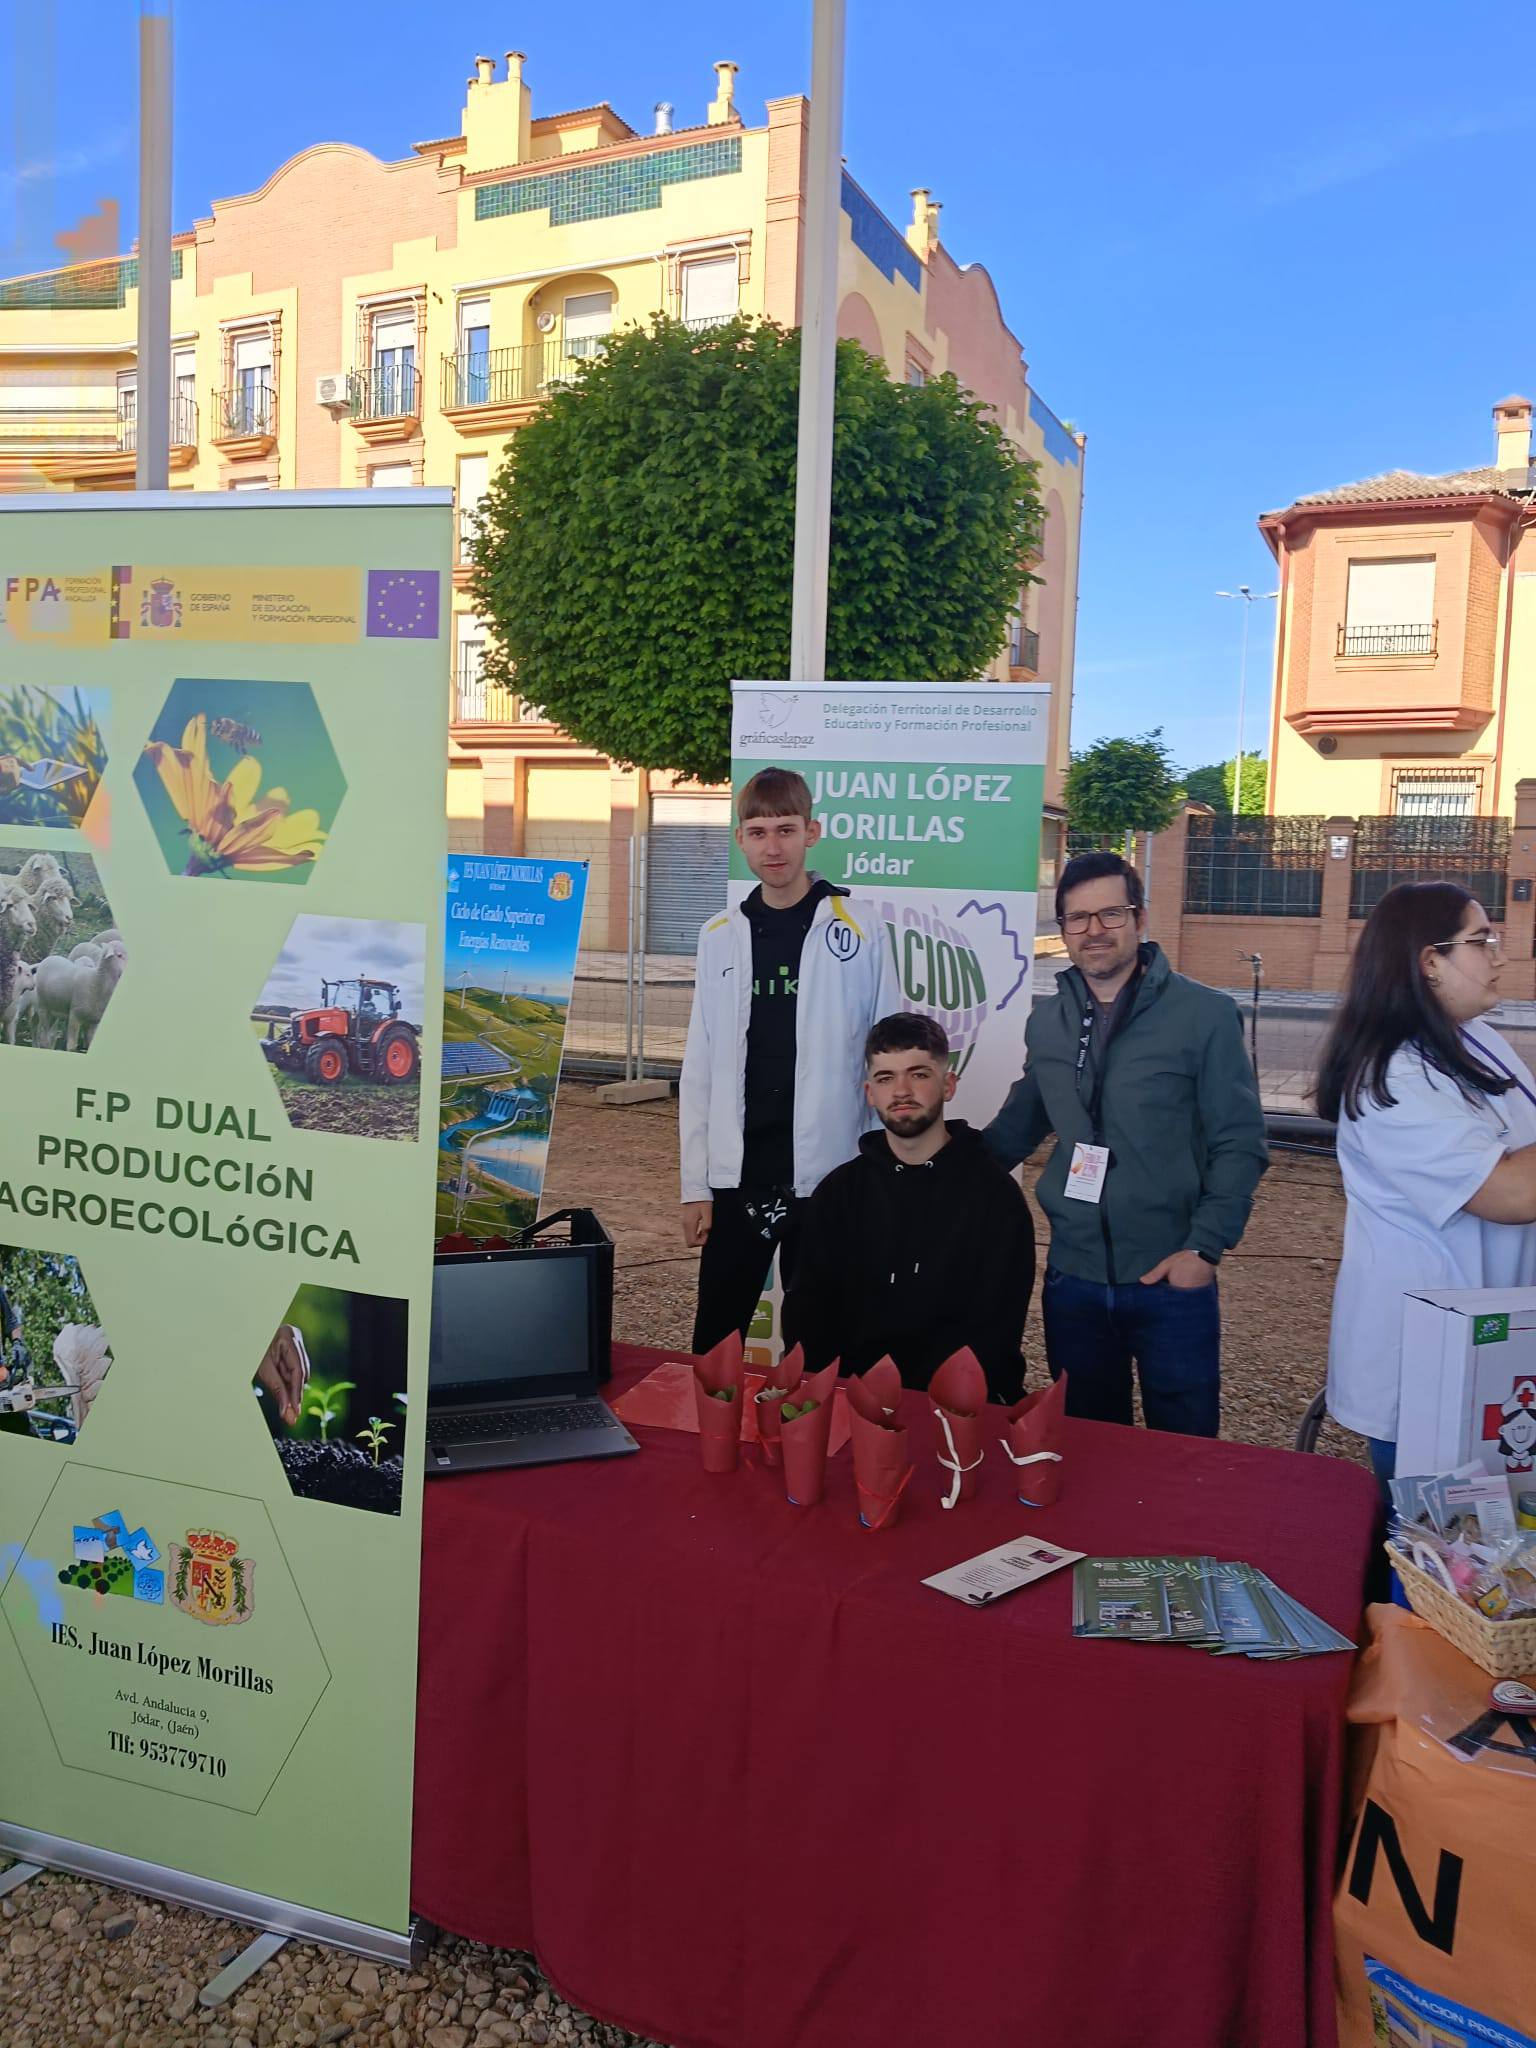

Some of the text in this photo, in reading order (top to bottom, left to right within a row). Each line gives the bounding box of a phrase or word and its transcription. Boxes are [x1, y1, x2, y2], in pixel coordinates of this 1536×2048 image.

[6, 577, 61, 602] FPA
[189, 593, 232, 602] GOBIERNO
[252, 594, 296, 602] MINISTERIO
[189, 601, 231, 612] DE ESPAÑA
[252, 604, 263, 612] DE
[822, 703, 1038, 717] Delegación Territorial de Desarrollo
[823, 718, 1032, 732] Educativo y Formación Profesional
[812, 766, 1012, 805] JUAN LÓPEZ
[842, 851, 914, 879] Jódar
[451, 901, 545, 929] Ciclo de Grado Superior en
[489, 932, 530, 953] Renovables
[75, 1087, 272, 1143] F.P DUAL
[51, 1621, 274, 1695] IES. Juan López Morillas
[114, 1688, 139, 1705] Avd.
[130, 1710, 201, 1740] Jódar, (Jaén)
[107, 1730, 227, 1779] Tlf: 953779710
